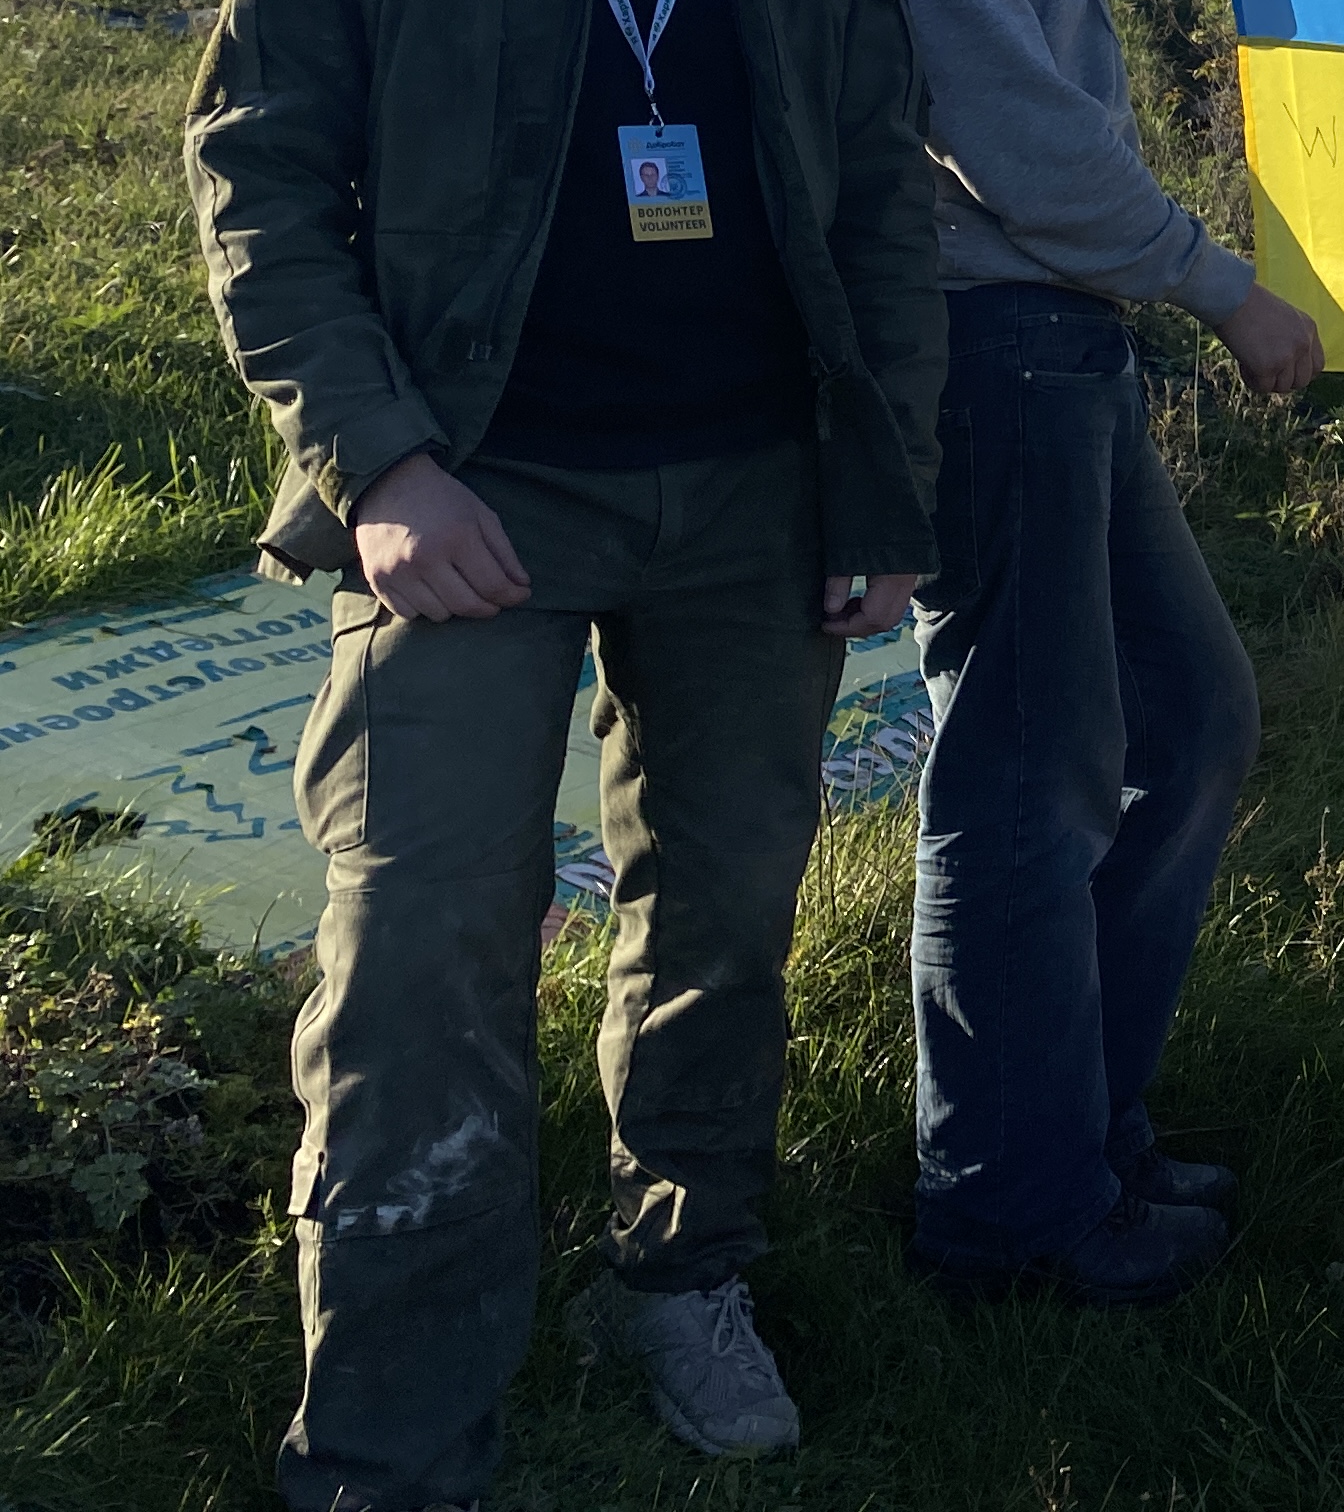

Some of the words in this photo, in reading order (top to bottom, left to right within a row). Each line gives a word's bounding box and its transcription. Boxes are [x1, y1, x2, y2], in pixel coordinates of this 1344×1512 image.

[637, 205, 704, 218] ВОЛОНТЕР
[639, 219, 707, 232] VOLUNTEER
[52, 608, 329, 692] коттеджи
[0, 638, 332, 750] лагоустроен
